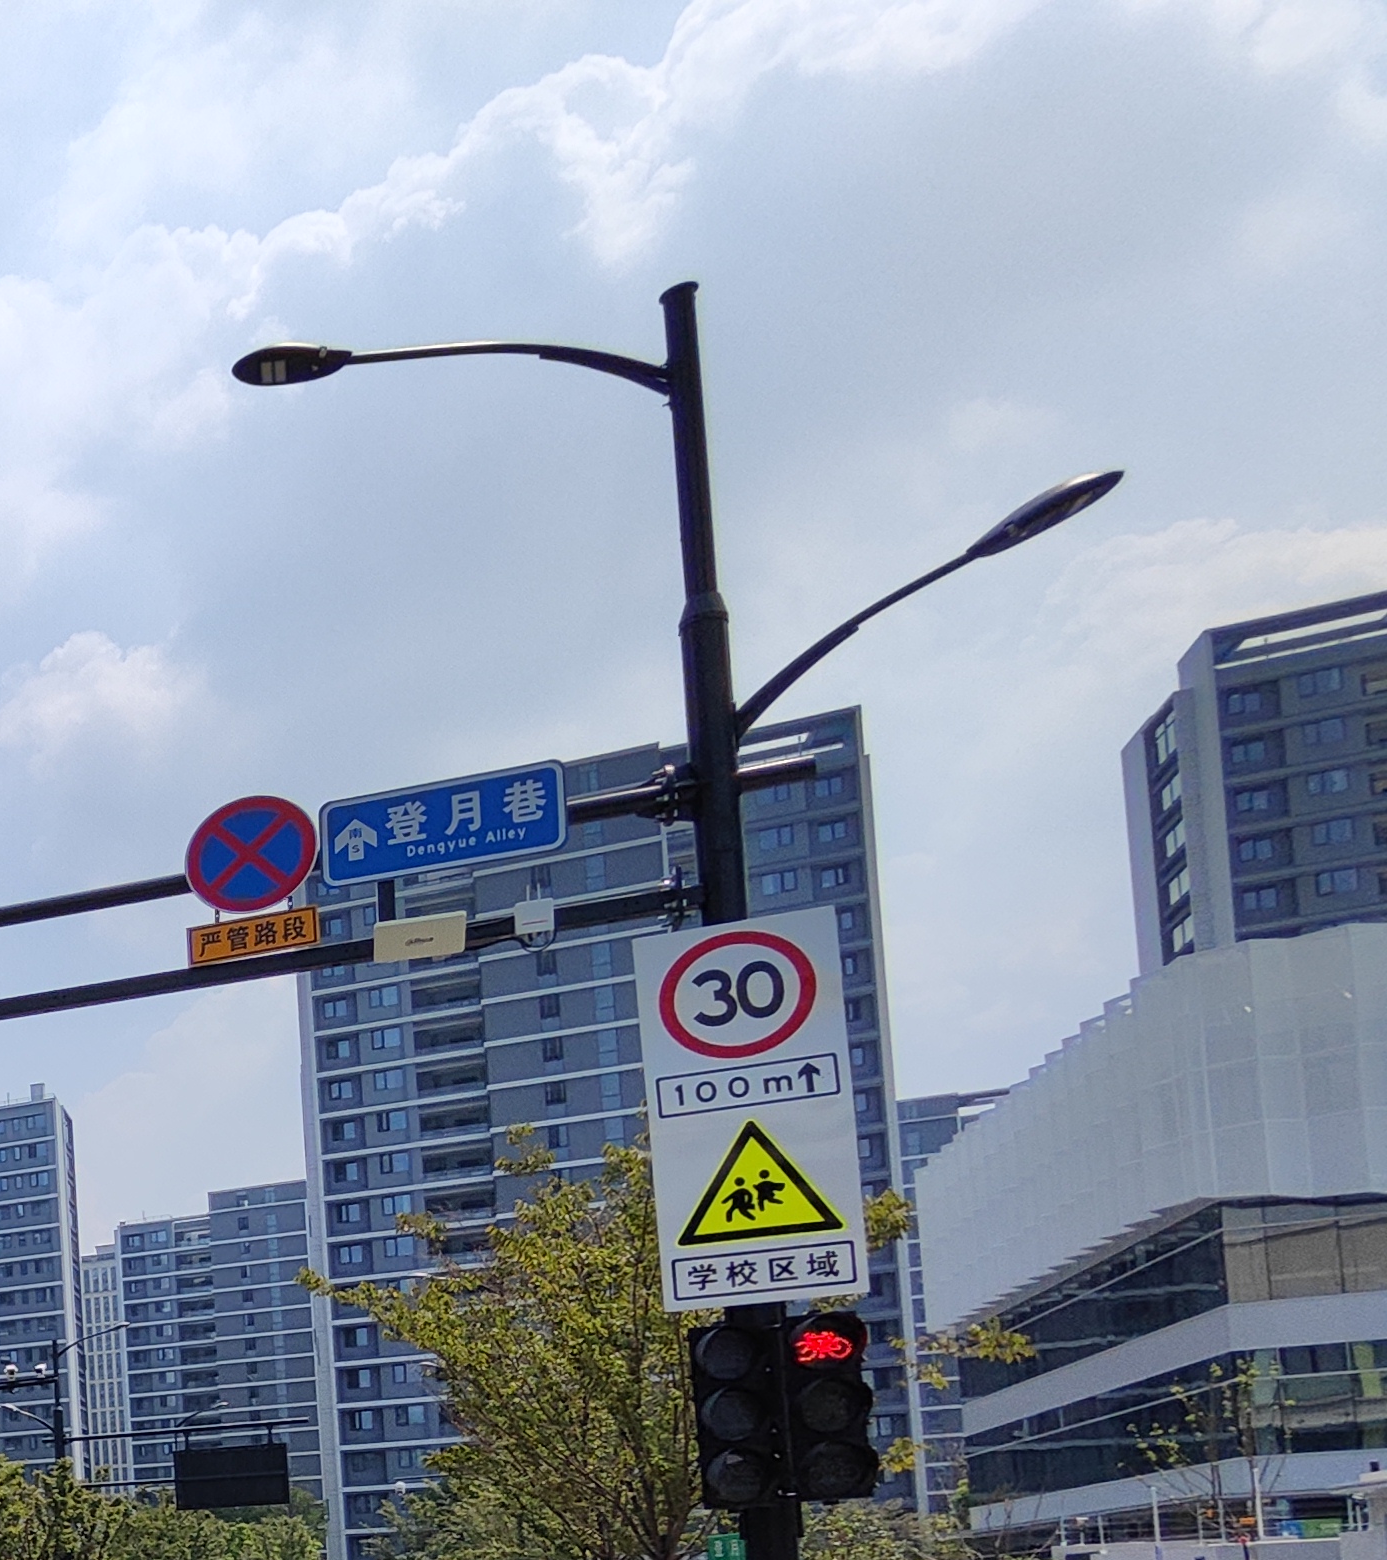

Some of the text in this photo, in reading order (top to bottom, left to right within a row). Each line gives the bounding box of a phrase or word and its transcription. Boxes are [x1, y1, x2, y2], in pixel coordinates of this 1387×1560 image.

[385, 779, 547, 846] 登月巷
[351, 844, 361, 854] S
[406, 827, 526, 857] Dengyue Alley
[199, 916, 307, 958] 严管路段
[691, 960, 785, 1027] 30
[688, 1250, 840, 1292] 学校区域
